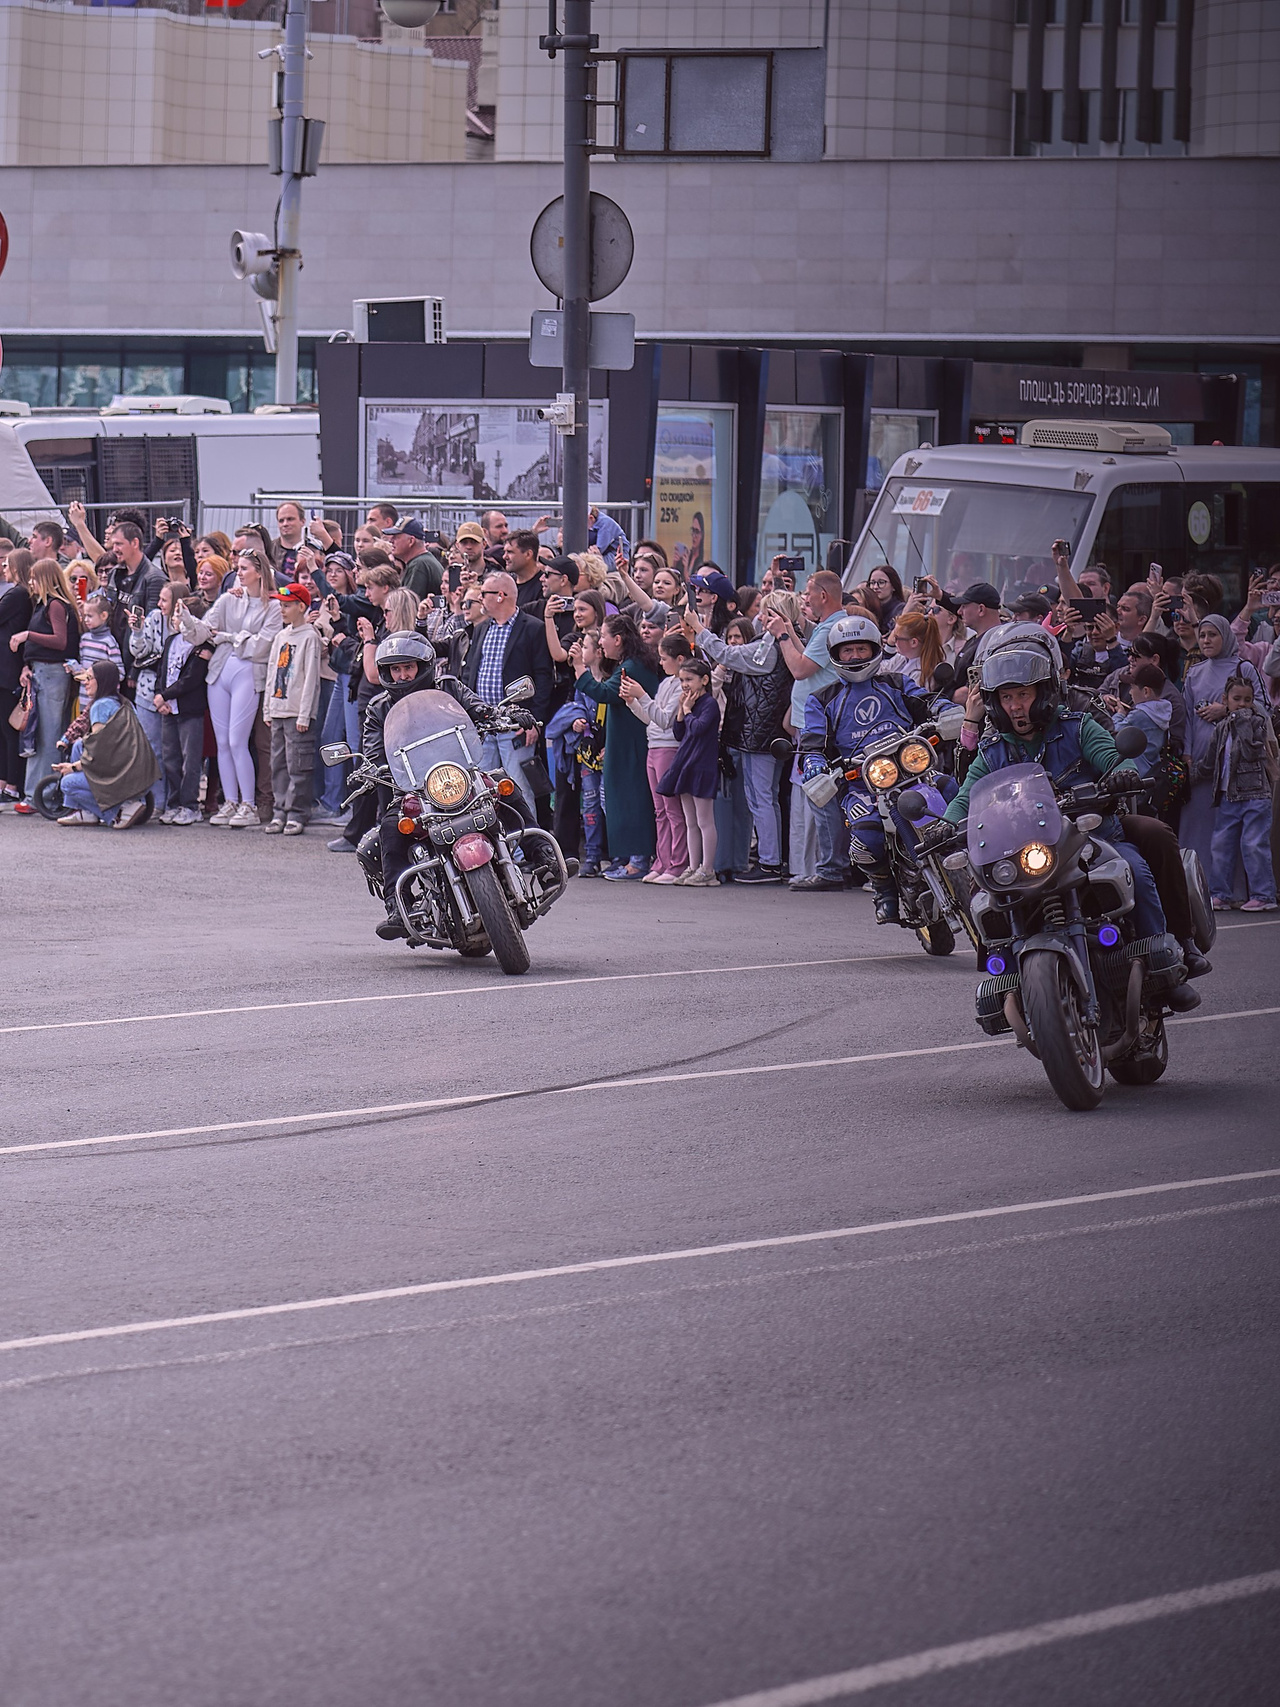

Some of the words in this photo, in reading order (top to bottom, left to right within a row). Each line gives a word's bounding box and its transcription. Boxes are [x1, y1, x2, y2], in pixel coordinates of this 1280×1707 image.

[1019, 379, 1065, 406] ПЛОЩАДЬ
[1067, 382, 1103, 408] БОРЦОВ
[912, 490, 933, 511] 66
[1191, 509, 1208, 536] 66
[874, 736, 896, 749] HONDA
